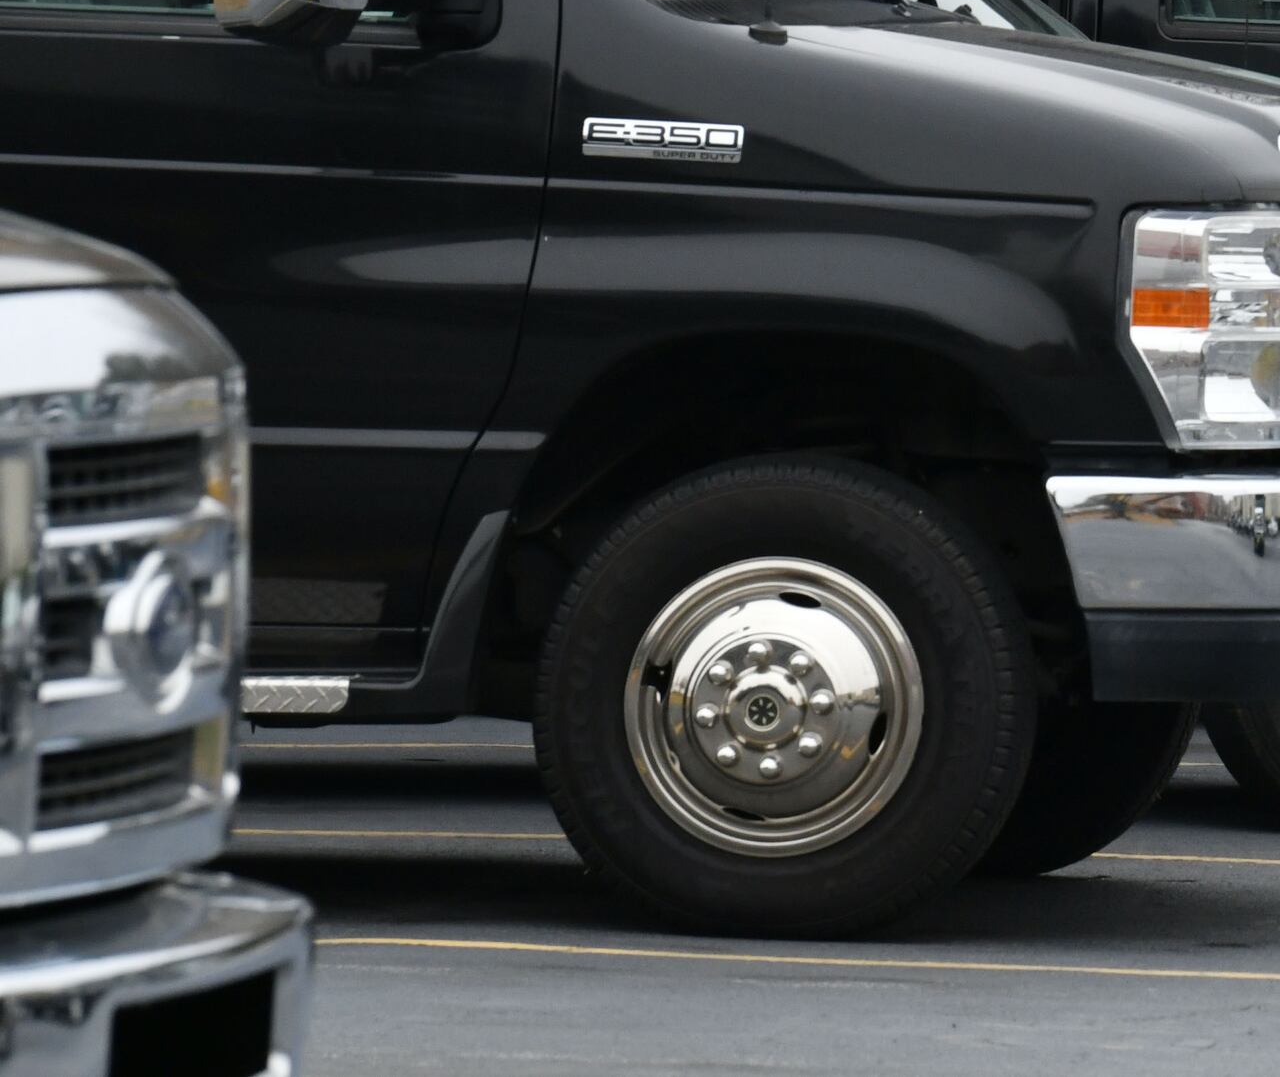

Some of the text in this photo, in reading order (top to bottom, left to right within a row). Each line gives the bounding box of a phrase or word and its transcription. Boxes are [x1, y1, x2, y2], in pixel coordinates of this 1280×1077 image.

[588, 122, 739, 148] E-350
[653, 149, 737, 161] SUPER DUTY
